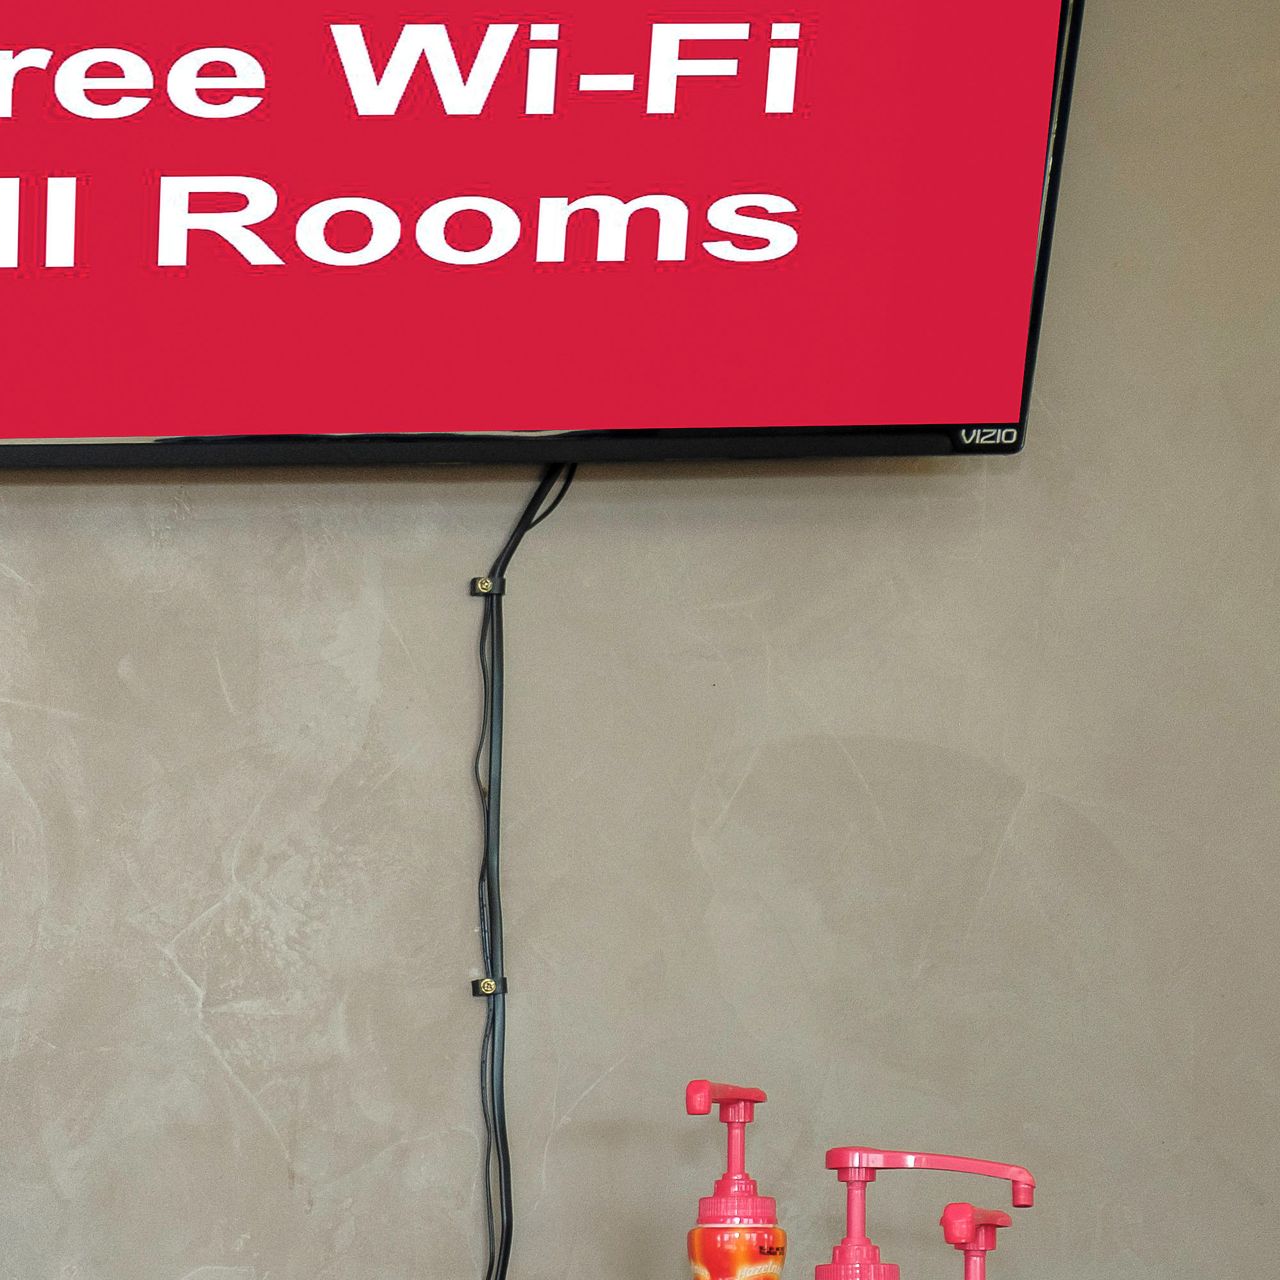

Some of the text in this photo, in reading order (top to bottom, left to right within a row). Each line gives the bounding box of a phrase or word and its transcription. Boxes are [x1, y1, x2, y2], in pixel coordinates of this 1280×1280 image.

[331, 22, 800, 117] Wi-Fi
[157, 174, 799, 266] Rooms
[961, 428, 1017, 444] VIZIO
